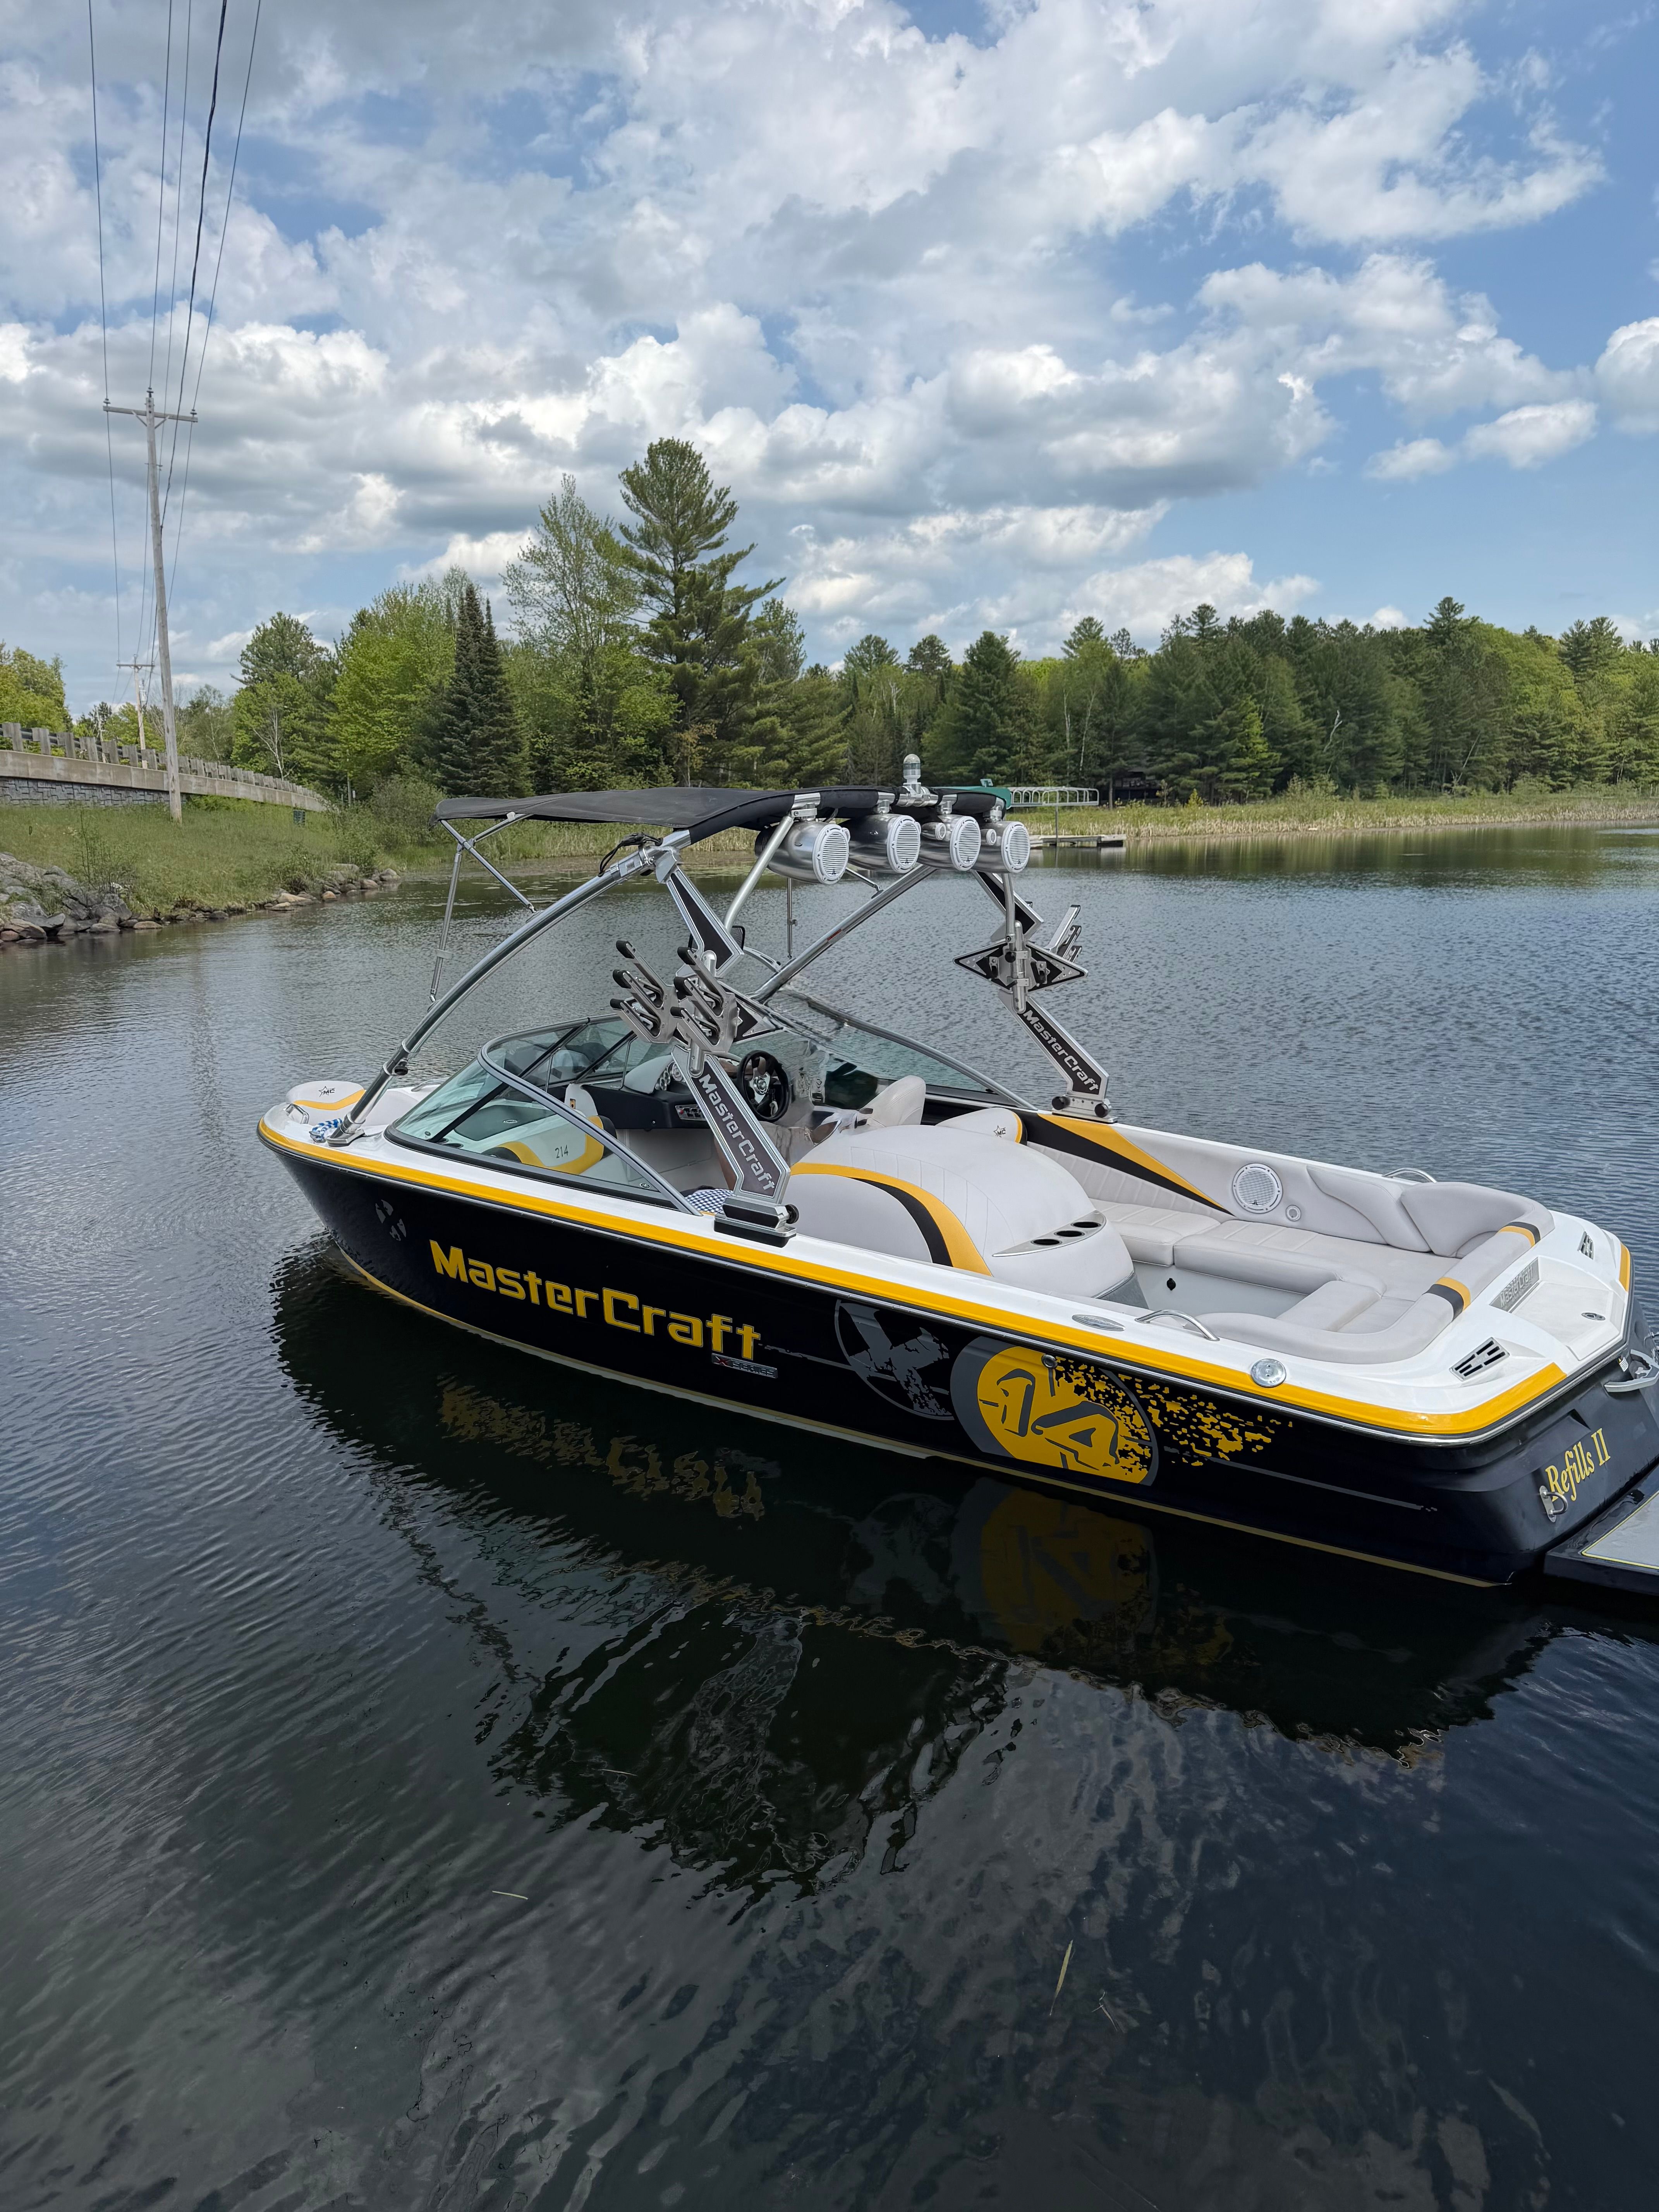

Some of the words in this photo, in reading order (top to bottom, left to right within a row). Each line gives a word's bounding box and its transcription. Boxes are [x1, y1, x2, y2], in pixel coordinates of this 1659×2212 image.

[1023, 1010, 1099, 1091] MasterCraft
[555, 1144, 568, 1159] 214
[699, 1073, 775, 1190] MasterCraft
[429, 1239, 761, 1361] MasterCraft
[1545, 1441, 1595, 1502] Refills
[1590, 1428, 1611, 1467] II
